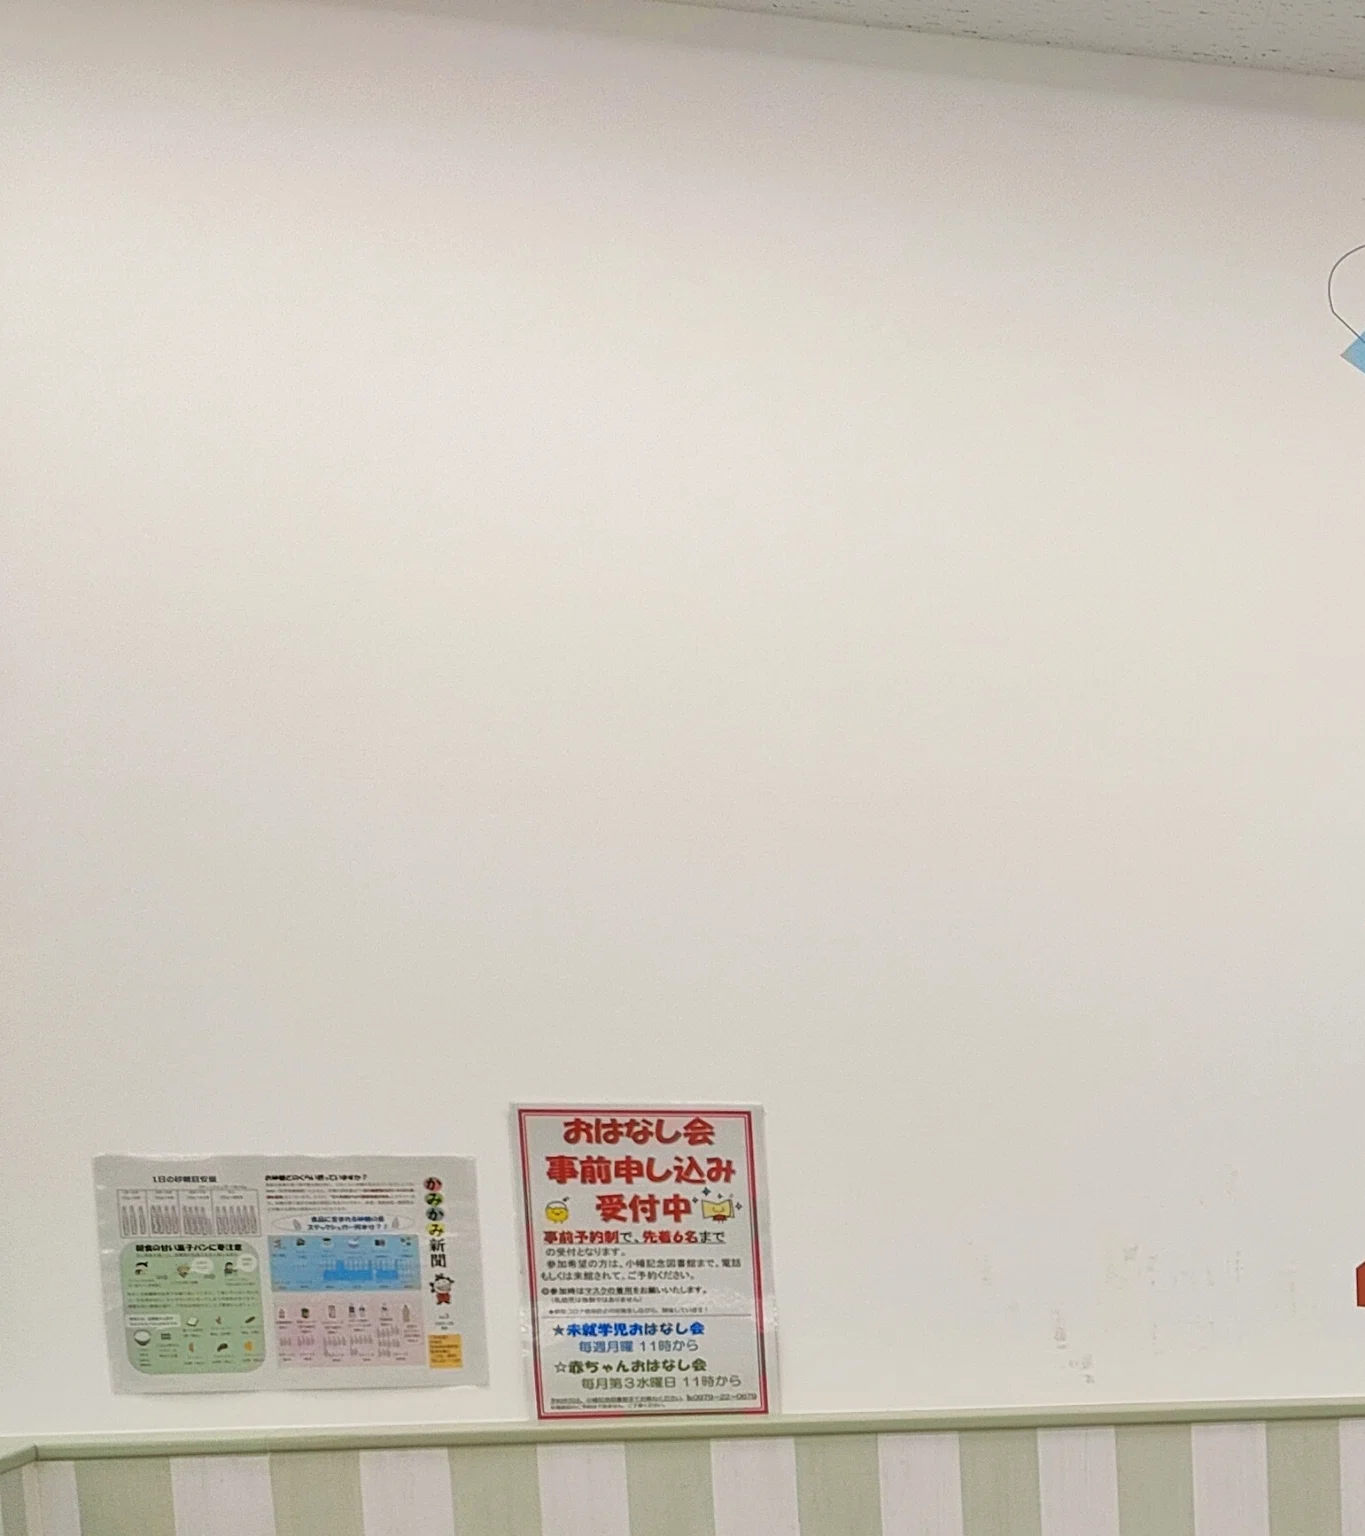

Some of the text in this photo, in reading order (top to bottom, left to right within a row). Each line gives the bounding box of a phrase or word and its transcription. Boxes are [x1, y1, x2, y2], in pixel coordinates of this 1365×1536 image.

[563, 1117, 716, 1146] おはなし会
[545, 1155, 736, 1185] 事前申し込み
[595, 1193, 692, 1223] 受付中
[566, 1320, 706, 1338] 未就学児おはなし会
[578, 1339, 634, 1354] 毎週月曜
[568, 1357, 708, 1375] 赤ちゃんおはなし会
